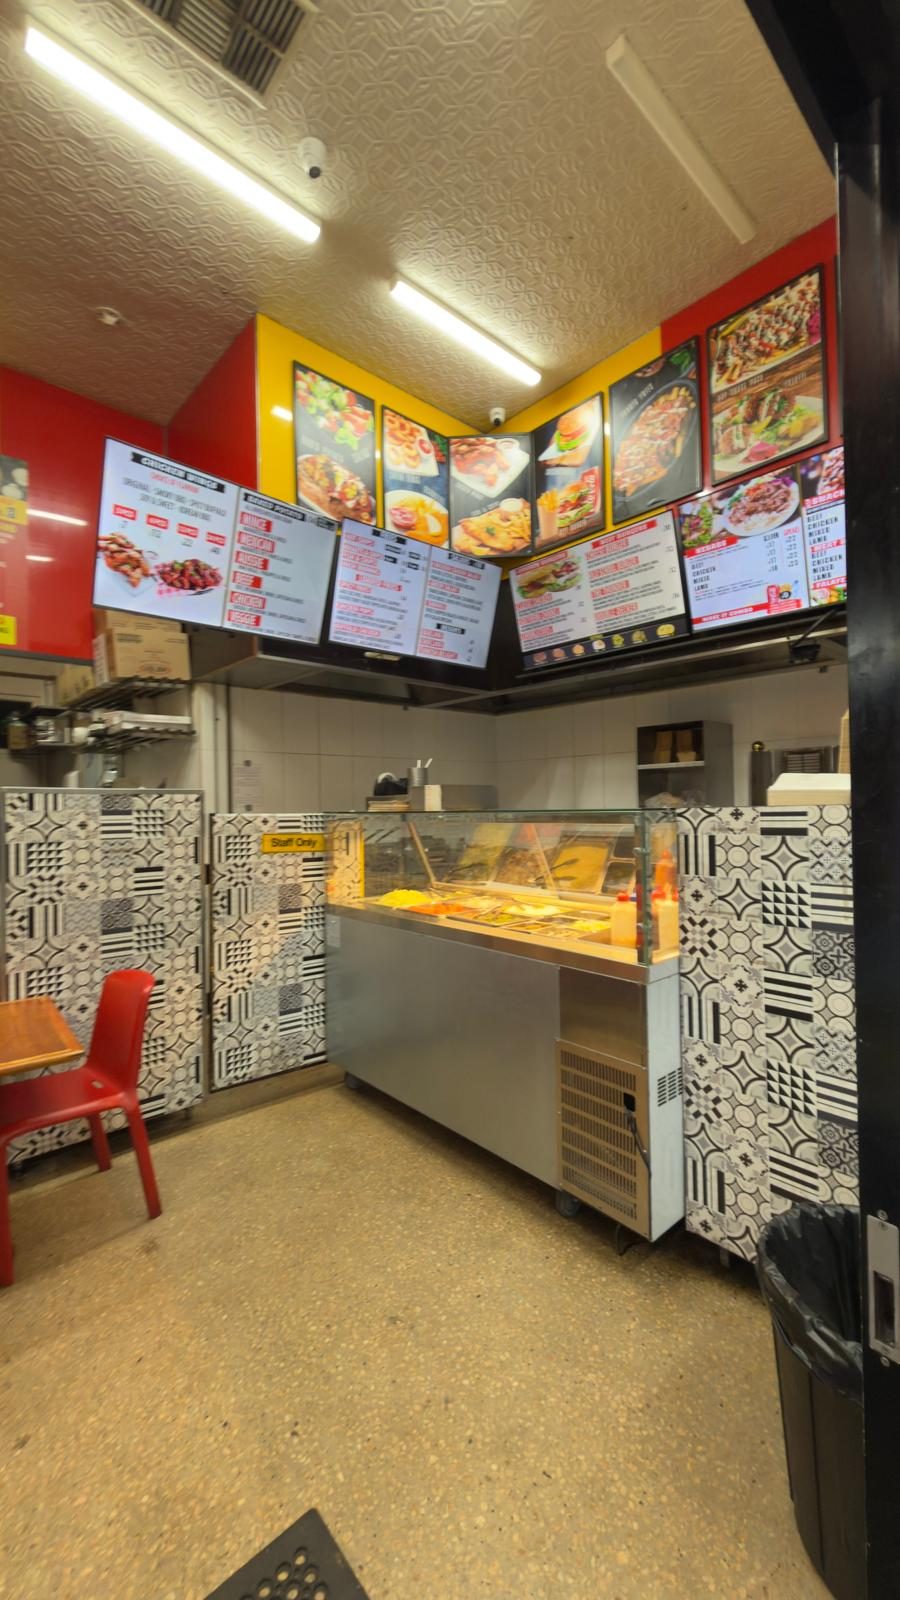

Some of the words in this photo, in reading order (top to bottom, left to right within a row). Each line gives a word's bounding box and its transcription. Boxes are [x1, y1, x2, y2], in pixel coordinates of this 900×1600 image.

[140, 457, 186, 479] CHICKEN
[185, 472, 219, 490] WINGS
[807, 514, 823, 523] BEEF
[807, 516, 838, 530] CHICKEN
[808, 527, 831, 538] MIXED
[809, 535, 828, 546] LAMB
[238, 552, 265, 569] AUSSIE
[811, 551, 827, 560] BEEF
[812, 554, 843, 567] CHICKEN
[692, 566, 716, 578] CHICKEN
[812, 564, 835, 574] MIXED
[693, 575, 710, 585] MIXED
[814, 572, 832, 582] LAMB
[694, 583, 709, 592] LAMB
[232, 593, 264, 609] CHICKEN
[230, 611, 256, 626] VEGGIE
[271, 837, 294, 849] Staff
[295, 837, 318, 849] Only
